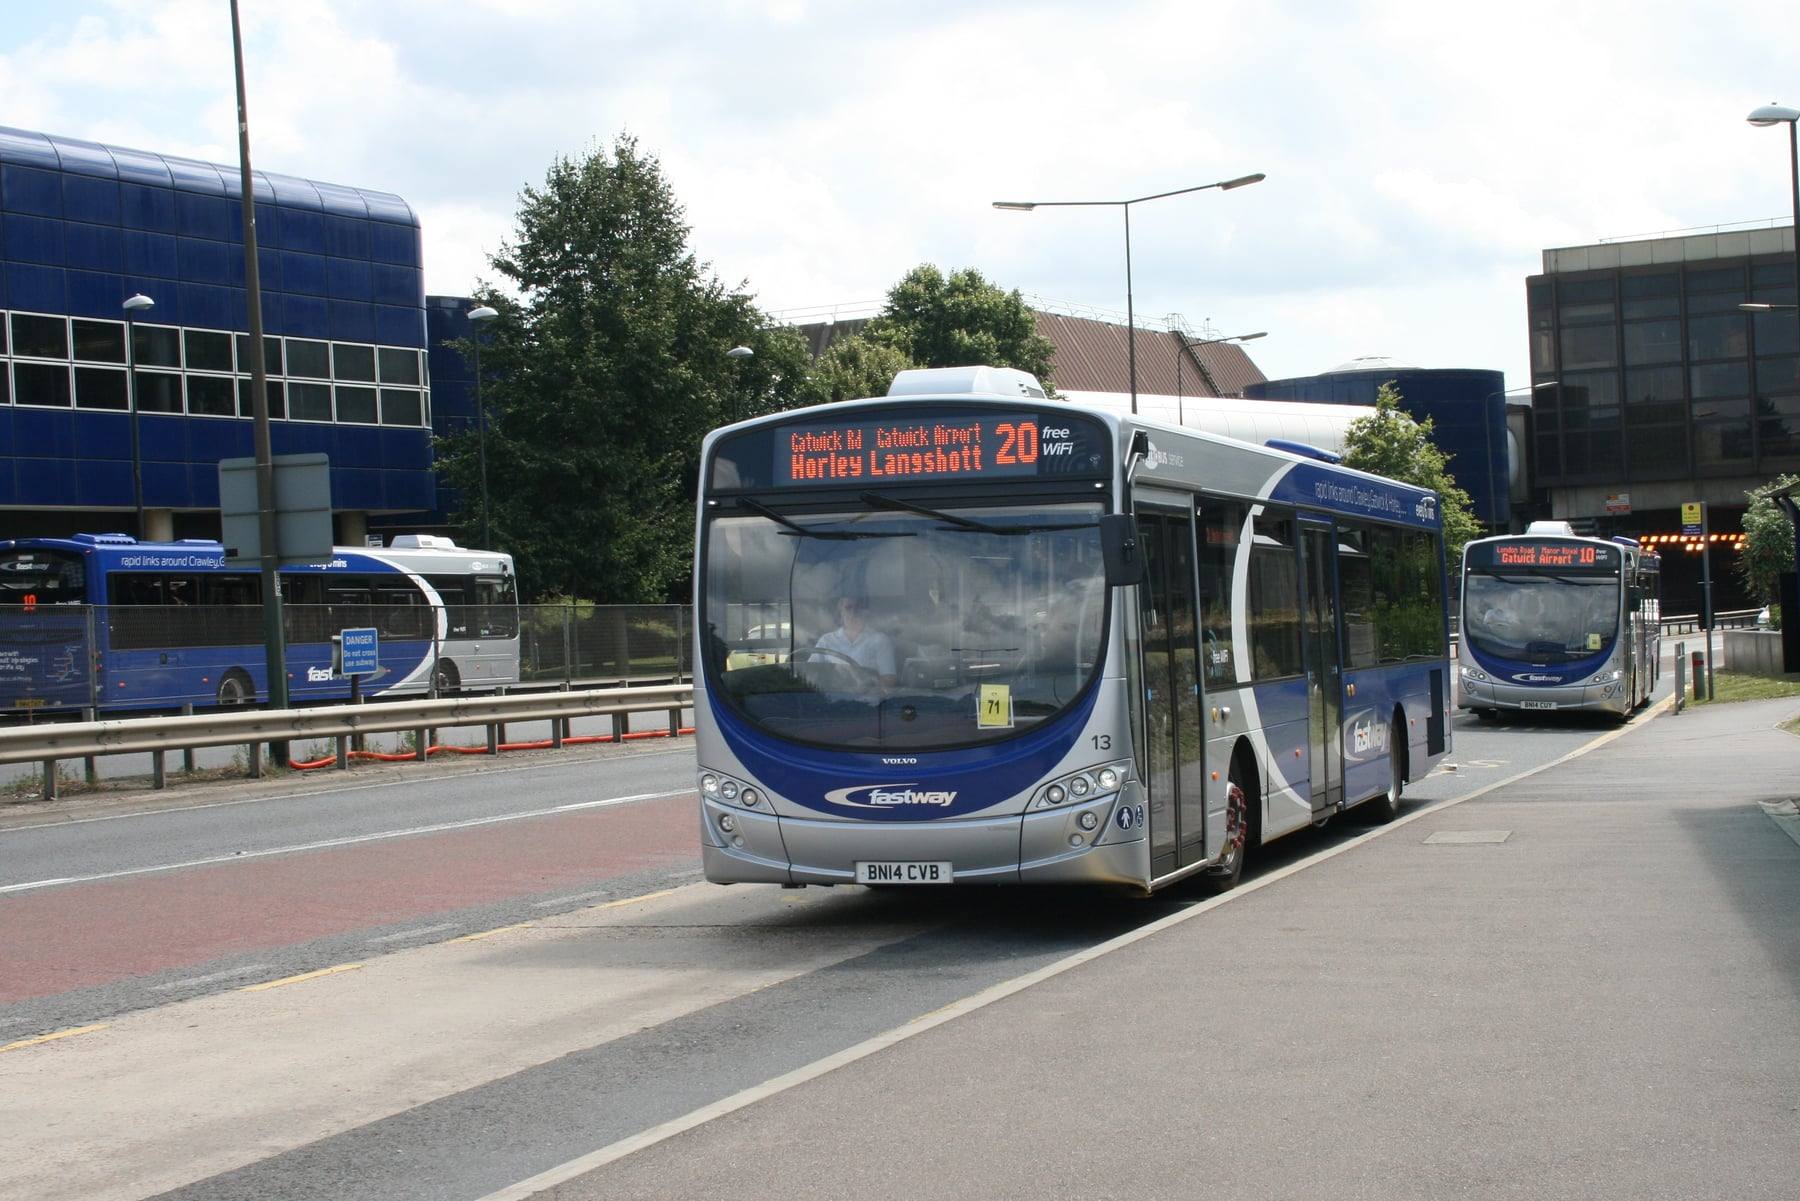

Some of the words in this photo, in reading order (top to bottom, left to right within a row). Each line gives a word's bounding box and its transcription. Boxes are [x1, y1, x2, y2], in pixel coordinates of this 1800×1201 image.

[791, 431, 842, 452] Gatwick
[847, 429, 862, 450] Rd
[877, 426, 929, 448] Gatwick
[934, 423, 981, 446] Airport
[1042, 426, 1070, 439] free
[995, 422, 1038, 464] 20
[1043, 442, 1073, 456] WiFi
[791, 452, 862, 480] Horley
[870, 445, 982, 476] Langshott
[1541, 547, 1560, 555] Manor
[1580, 547, 1594, 563] 10
[121, 556, 141, 568] rapid
[142, 556, 160, 566] links
[161, 556, 188, 567] around
[1502, 553, 1536, 564] Gatwick
[1539, 554, 1572, 564] Airport
[16, 563, 49, 571] fastway
[346, 635, 373, 645] DANGER
[1529, 675, 1562, 683] fastway
[988, 700, 1000, 714] 71
[1091, 735, 1111, 750] 13
[1354, 720, 1387, 753] fastway
[868, 789, 958, 807] fastway
[867, 864, 902, 880] BN14
[907, 864, 940, 881] CVB
